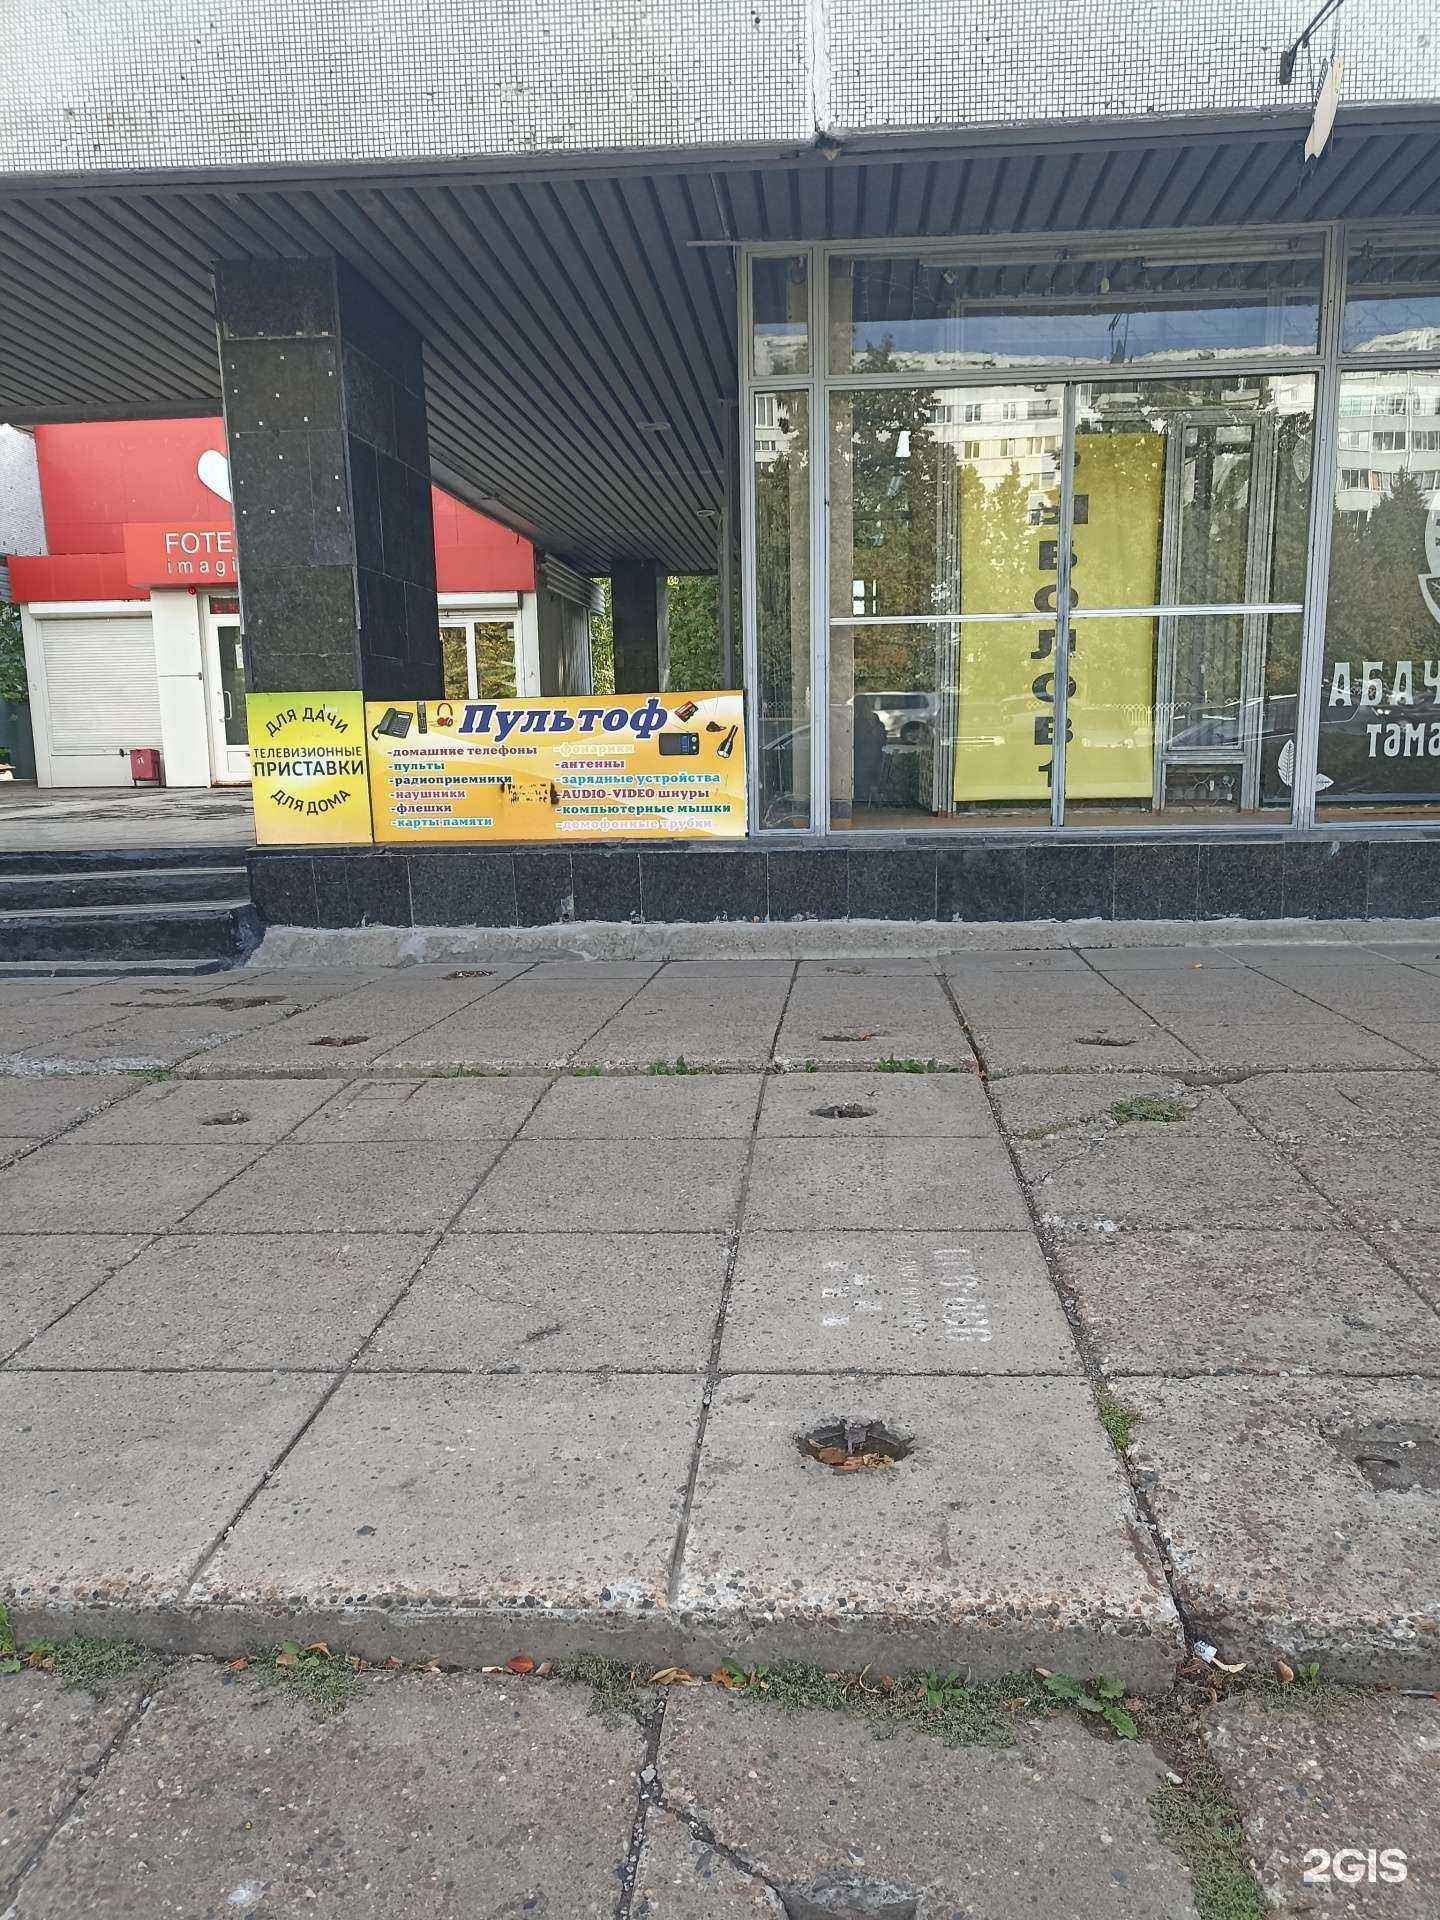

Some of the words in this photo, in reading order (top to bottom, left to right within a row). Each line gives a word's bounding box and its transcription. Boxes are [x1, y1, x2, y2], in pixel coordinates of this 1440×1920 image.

[265, 708, 297, 737] ДЛЯ
[302, 706, 349, 734] ДАЧИ
[458, 698, 667, 742] Пультоф
[253, 746, 362, 758] ТЕЛЕВИЗИОННЫЕ
[467, 745, 537, 757] телефоны
[253, 760, 364, 776] ПРИСТАВКИ
[636, 771, 720, 785] устройства
[658, 789, 709, 799] шнуры
[271, 789, 303, 812] ДЛЯ
[306, 789, 350, 816] ДОМА
[677, 804, 731, 813] мышки
[443, 818, 492, 827] памяти
